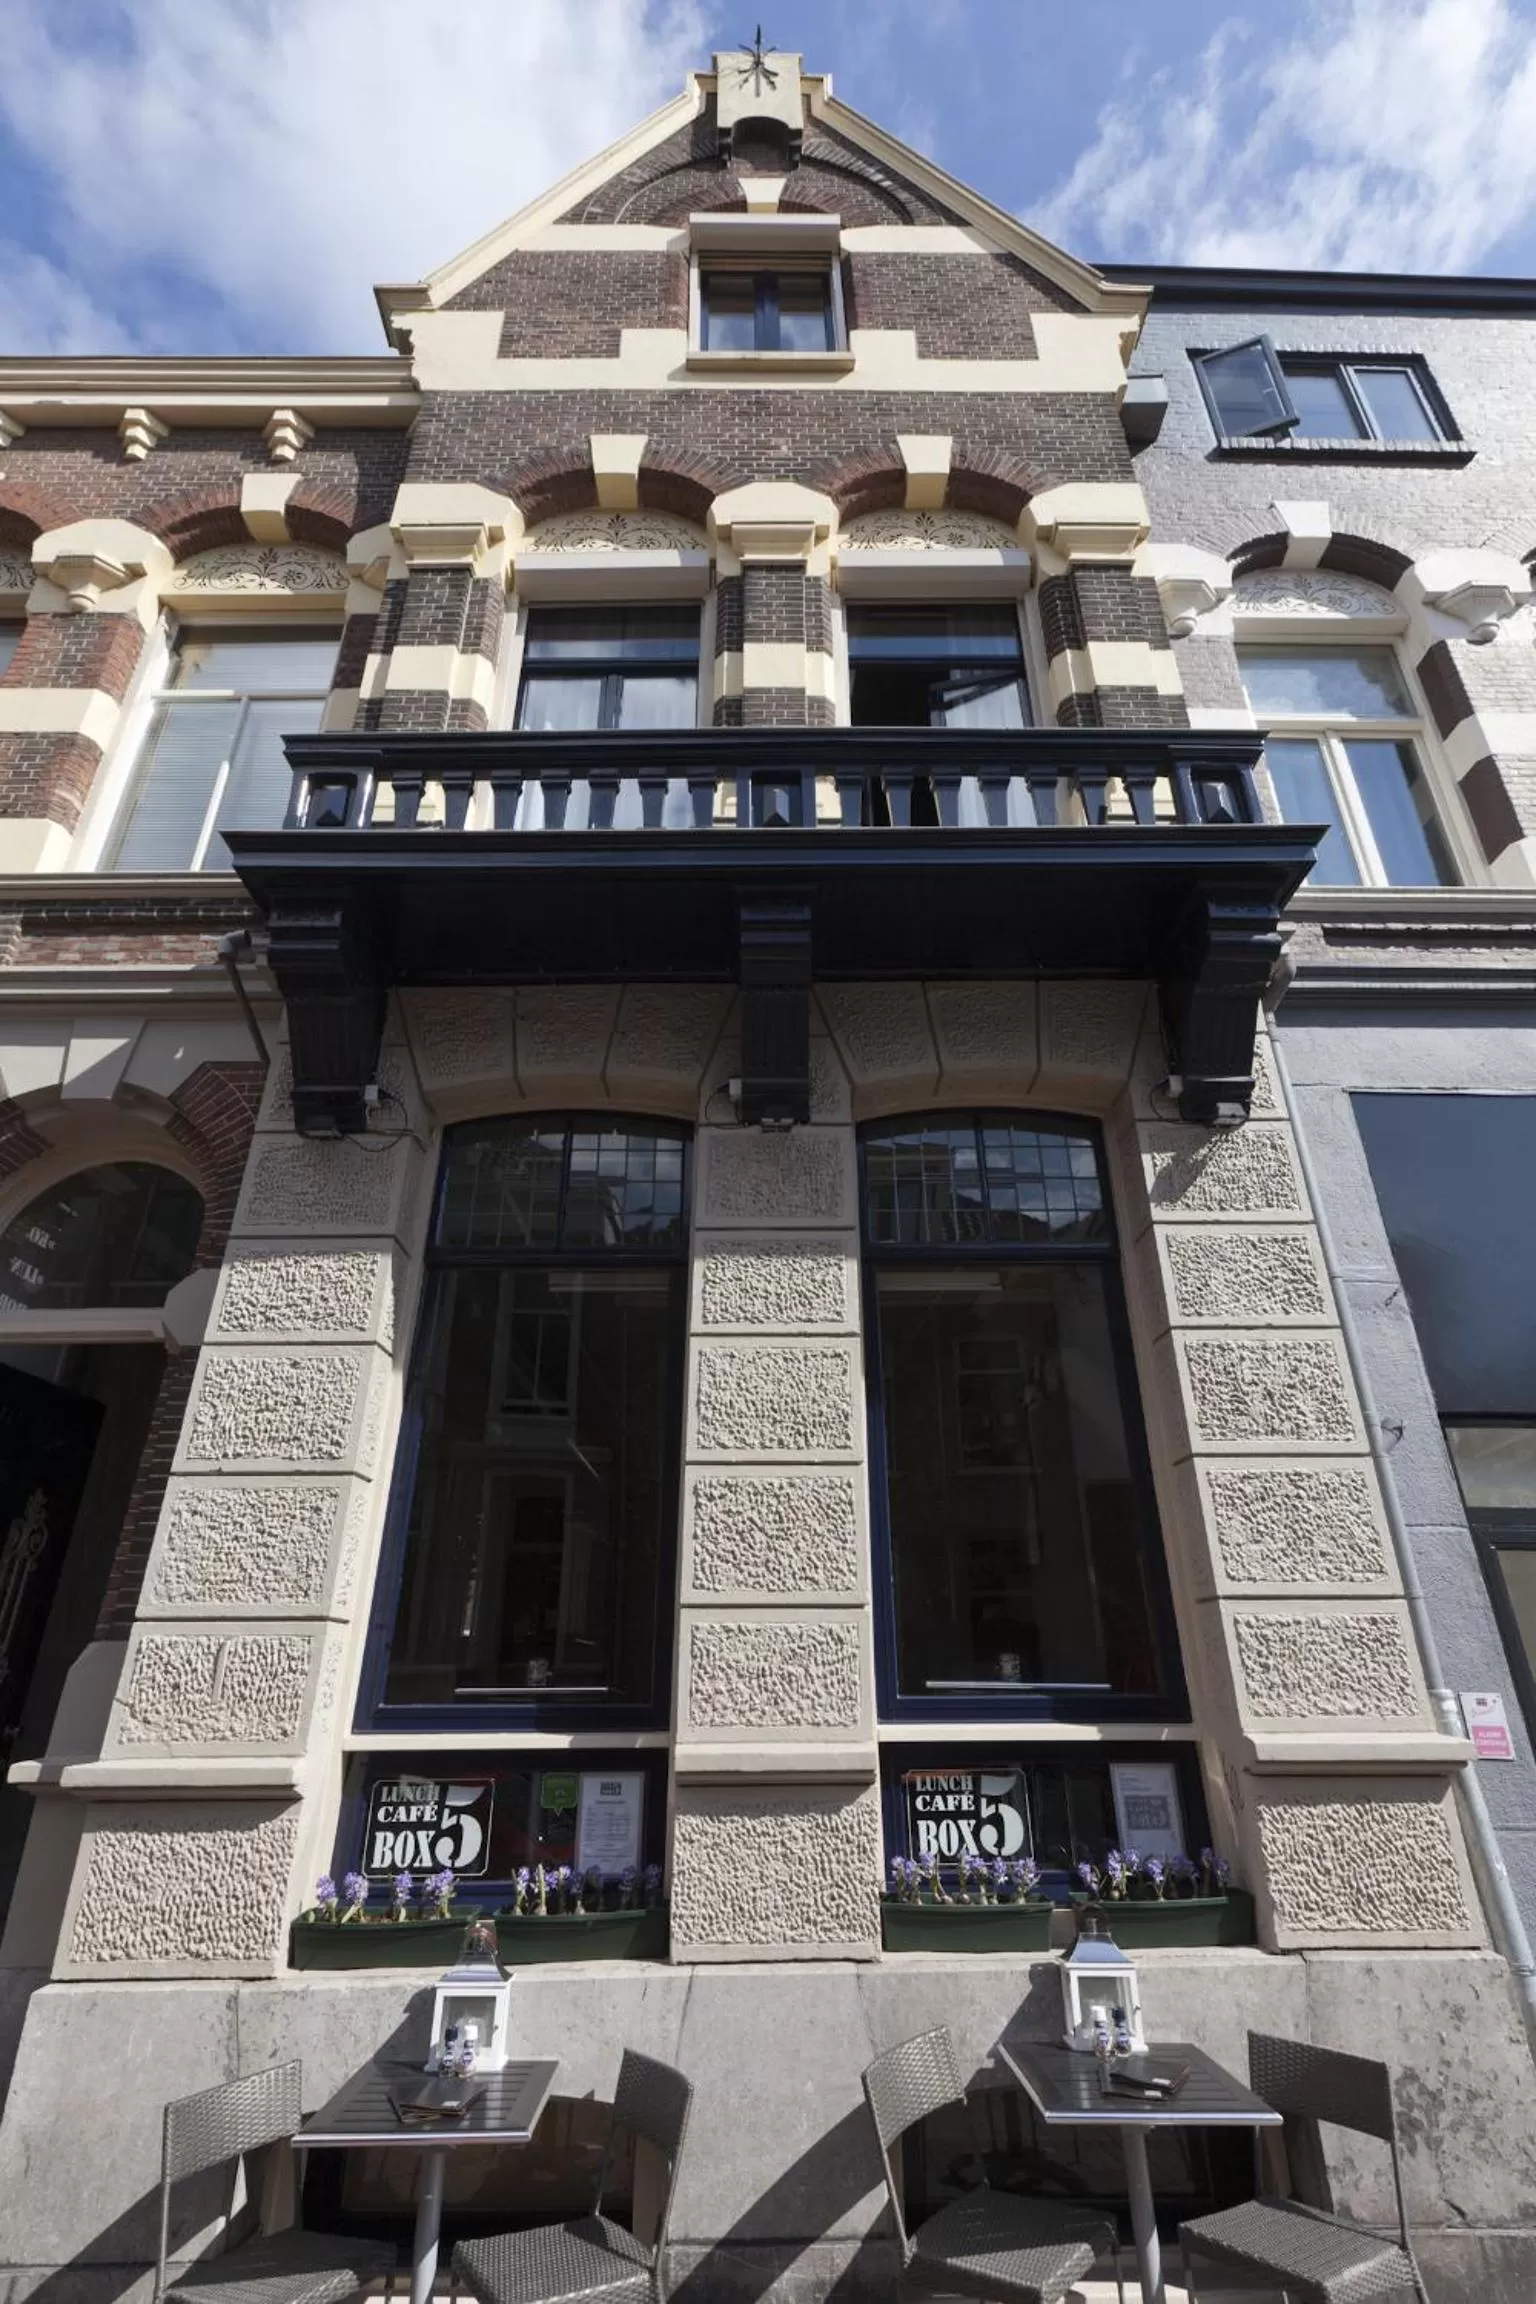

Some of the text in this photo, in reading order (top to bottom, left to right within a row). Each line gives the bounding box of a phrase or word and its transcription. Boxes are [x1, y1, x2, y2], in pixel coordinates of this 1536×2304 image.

[381, 1786, 440, 1802] LUNCH
[915, 1774, 974, 1792] LUNCH
[377, 1802, 437, 1823] CAFÉ
[915, 1793, 976, 1812] CAFÉ
[979, 1774, 1025, 1857] 5
[434, 1784, 486, 1868] 5
[917, 1819, 980, 1857] BOX
[370, 1830, 436, 1869] BOX
